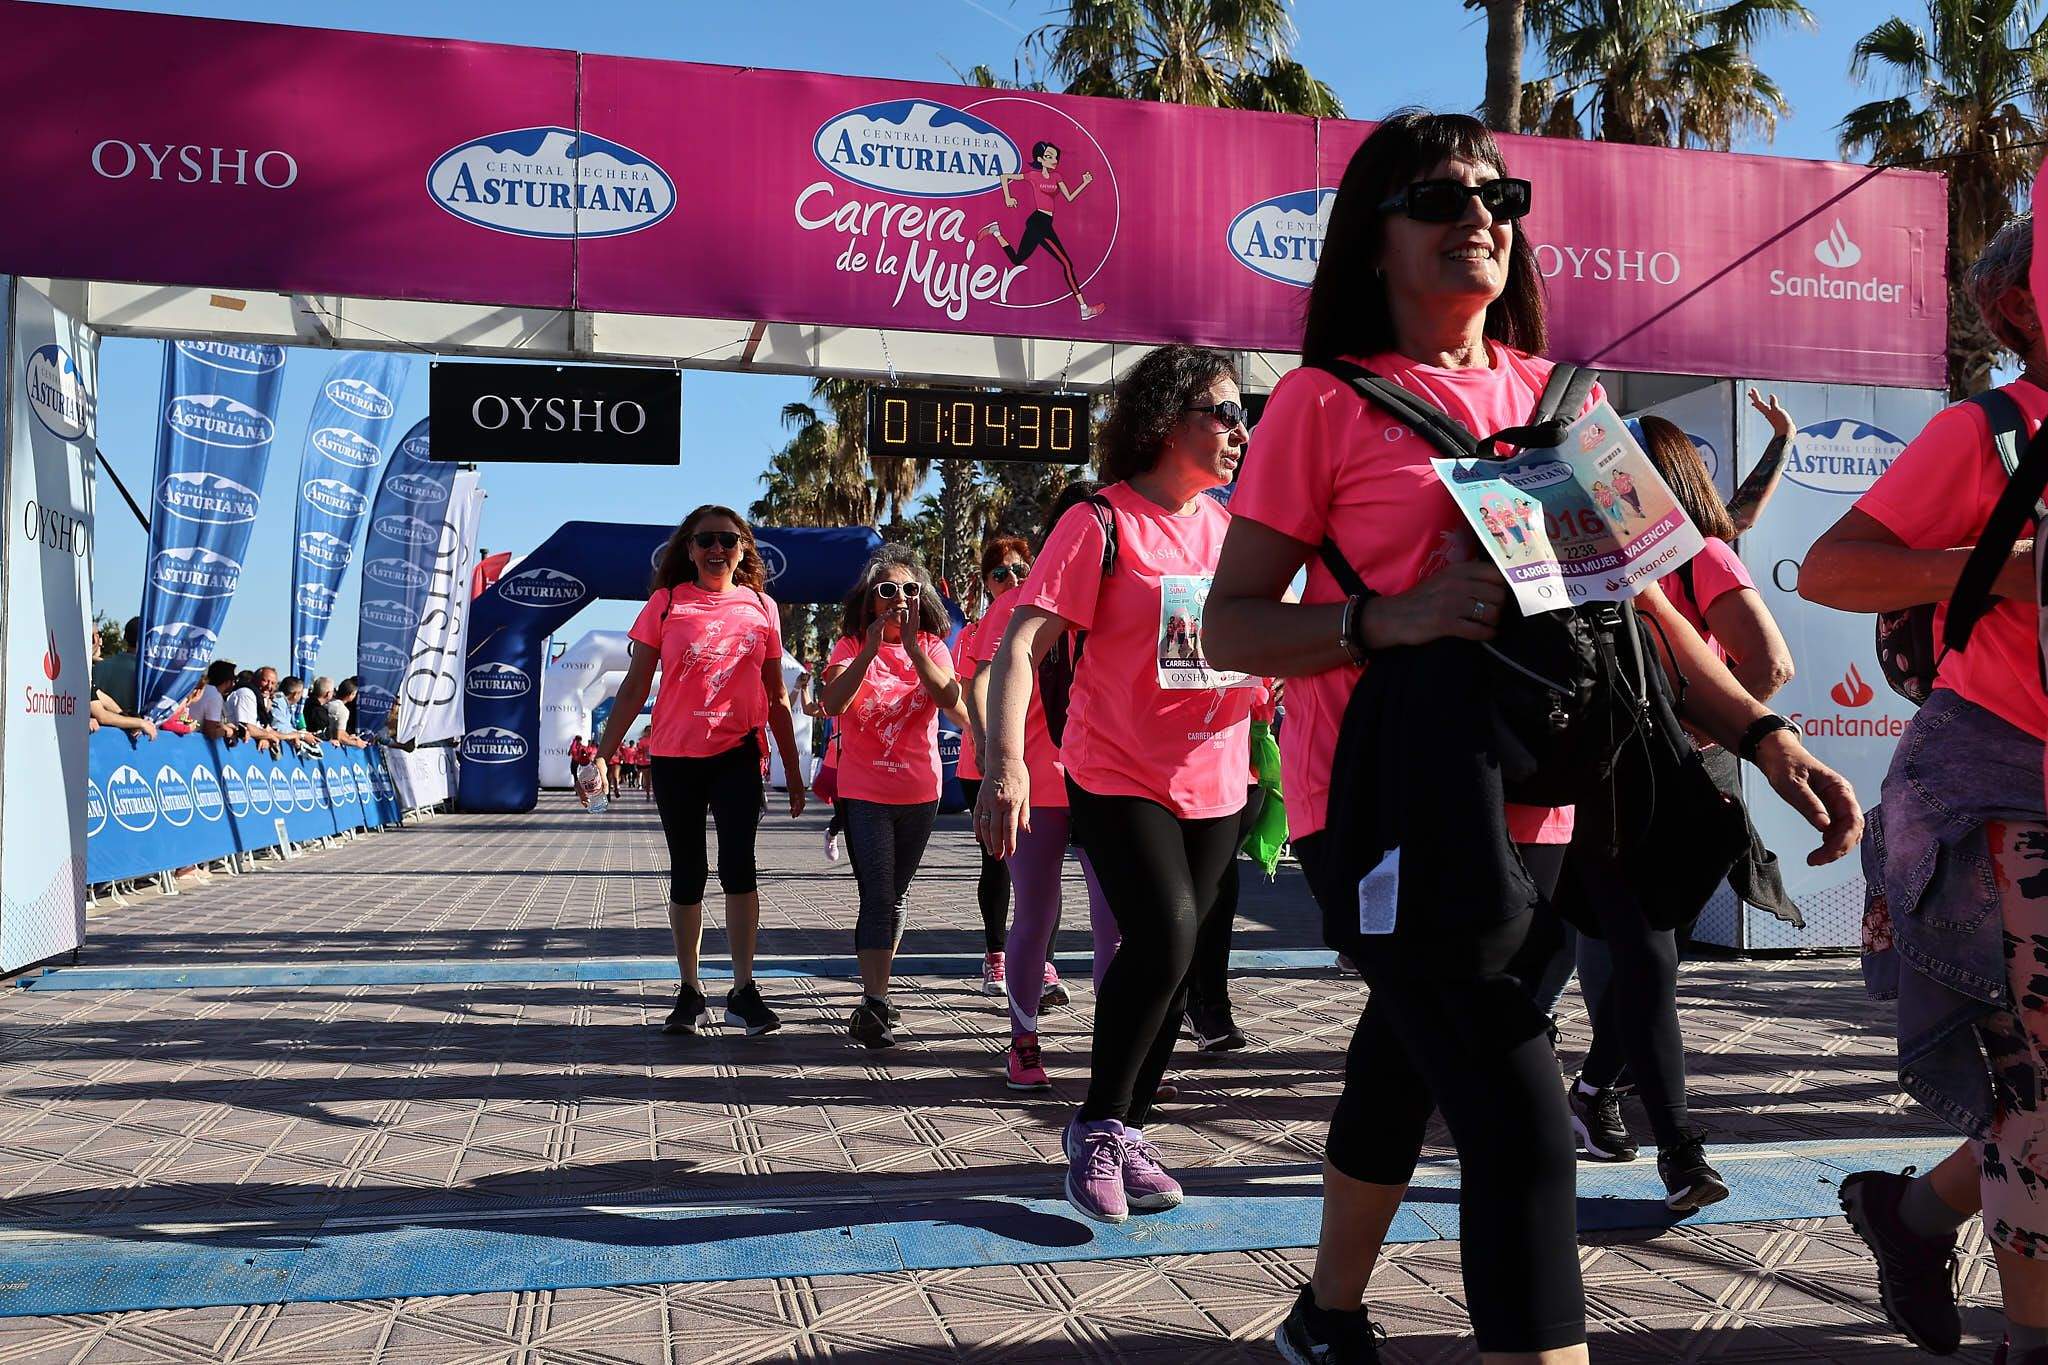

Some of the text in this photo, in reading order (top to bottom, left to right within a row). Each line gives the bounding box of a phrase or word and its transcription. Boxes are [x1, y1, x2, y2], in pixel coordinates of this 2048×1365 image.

[829, 127, 1007, 178] ASTURIANA
[862, 127, 1000, 149] CENTRAL LECHERA
[92, 139, 298, 191] OYSHO
[486, 161, 563, 177] CENTRAL
[446, 161, 658, 214] ASTURIANA
[794, 181, 965, 243] Carrera
[1243, 220, 1325, 263] ASTU
[836, 237, 1028, 321] de la Mujer
[1533, 244, 1681, 285] OYSHO
[1769, 269, 1905, 303] Santander
[31, 365, 85, 427] ASTURIANA
[330, 385, 389, 416] ASTURIANA
[171, 404, 266, 440] ASTURIANA
[471, 394, 647, 436] OYSHO
[317, 433, 376, 463] ASTURIANA
[1785, 444, 1893, 476] ASTURIAN
[1806, 443, 1850, 453] CENTRAL
[163, 483, 255, 517] ASTURIANA
[306, 484, 364, 512] ASTURIANA
[24, 500, 87, 557] OYSHO
[1564, 544, 1597, 560] 2238
[1569, 562, 1581, 574] LA
[1582, 556, 1618, 572] MUJER
[1624, 519, 1674, 558] VALENCIA
[154, 563, 237, 590] ASTURIANA
[1619, 545, 1679, 588] Santander
[504, 582, 578, 598] ASTURIANA
[1165, 660, 1194, 668] CARRERA
[1171, 672, 1209, 682] OYSHO
[466, 675, 526, 690] ASTURIANA
[25, 685, 77, 716] Santander
[464, 740, 523, 755] ASTURIANA
[112, 789, 156, 816] ASTURIANA
